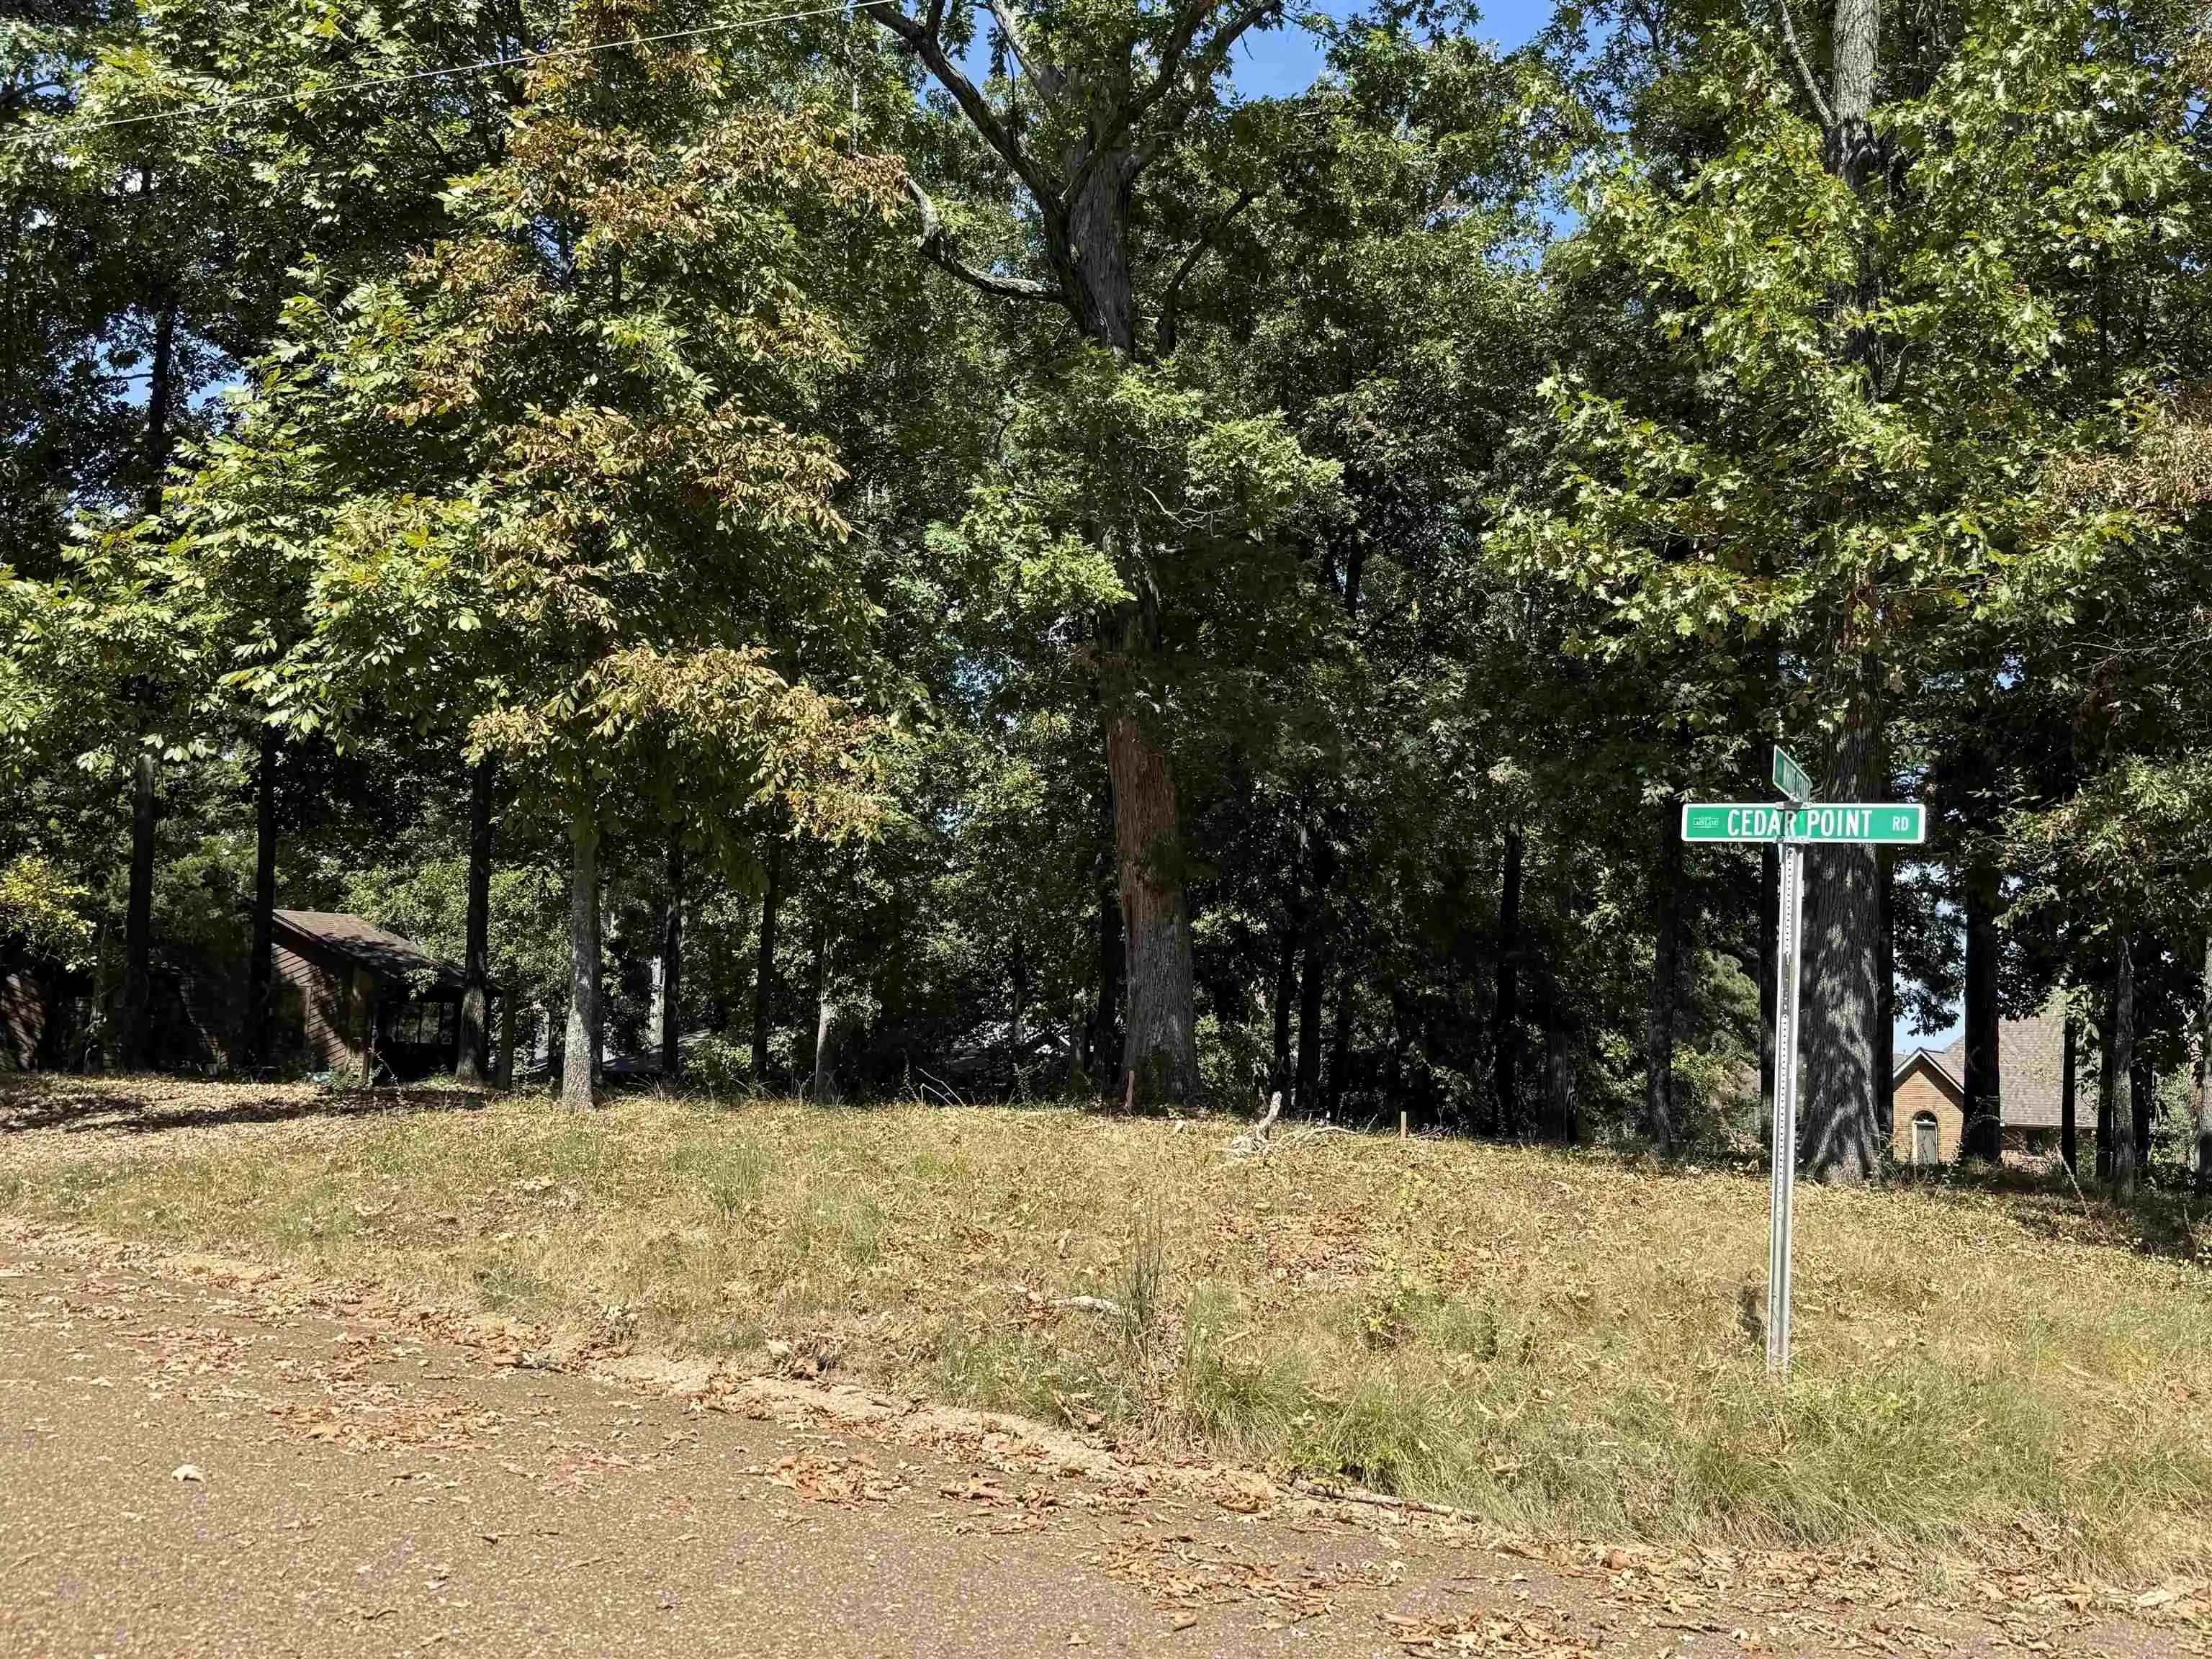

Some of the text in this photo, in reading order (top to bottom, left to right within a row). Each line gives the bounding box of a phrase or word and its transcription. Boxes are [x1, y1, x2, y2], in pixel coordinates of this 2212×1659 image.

[1728, 809, 1909, 837] CEDAR POINT RD
